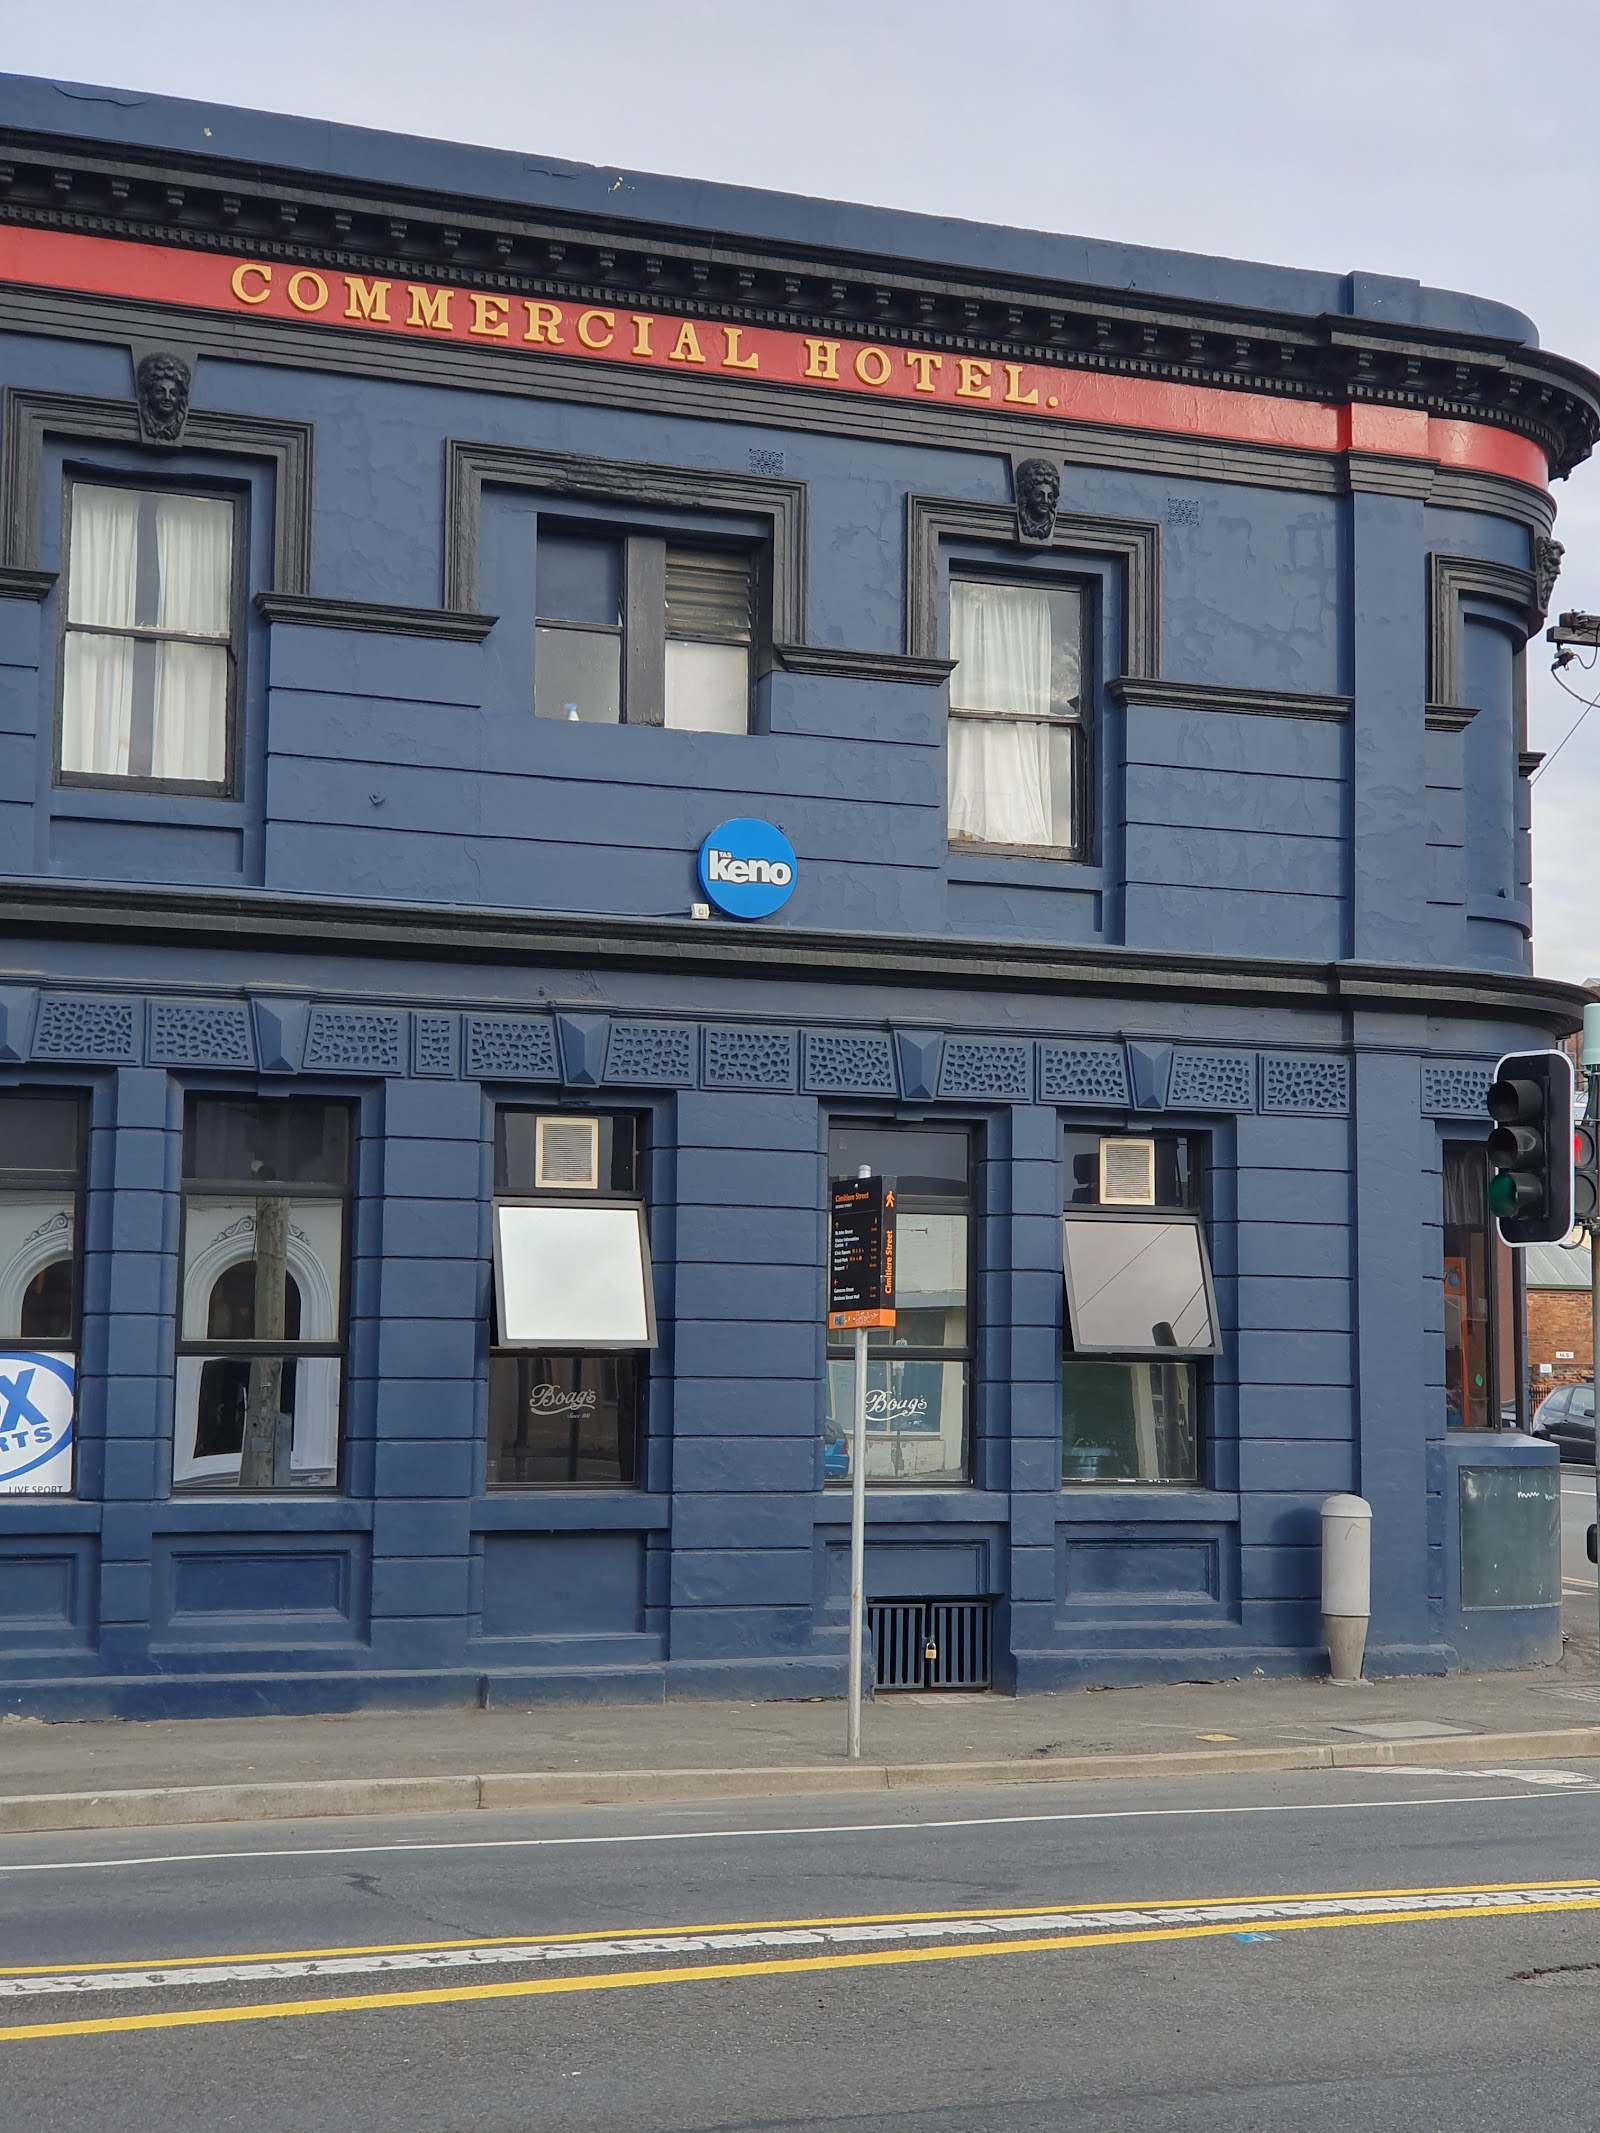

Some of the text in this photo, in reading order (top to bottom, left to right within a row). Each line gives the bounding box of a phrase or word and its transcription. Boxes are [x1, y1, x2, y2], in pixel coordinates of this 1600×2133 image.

[231, 263, 759, 370] COMMERCIAL
[708, 848, 792, 887] keno
[835, 1192, 869, 1202] Cimitiere Street
[884, 1230, 893, 1294] Cimitiere Street
[529, 1383, 597, 1416] Boag's
[8, 1485, 64, 1494] LIVE SPORT
